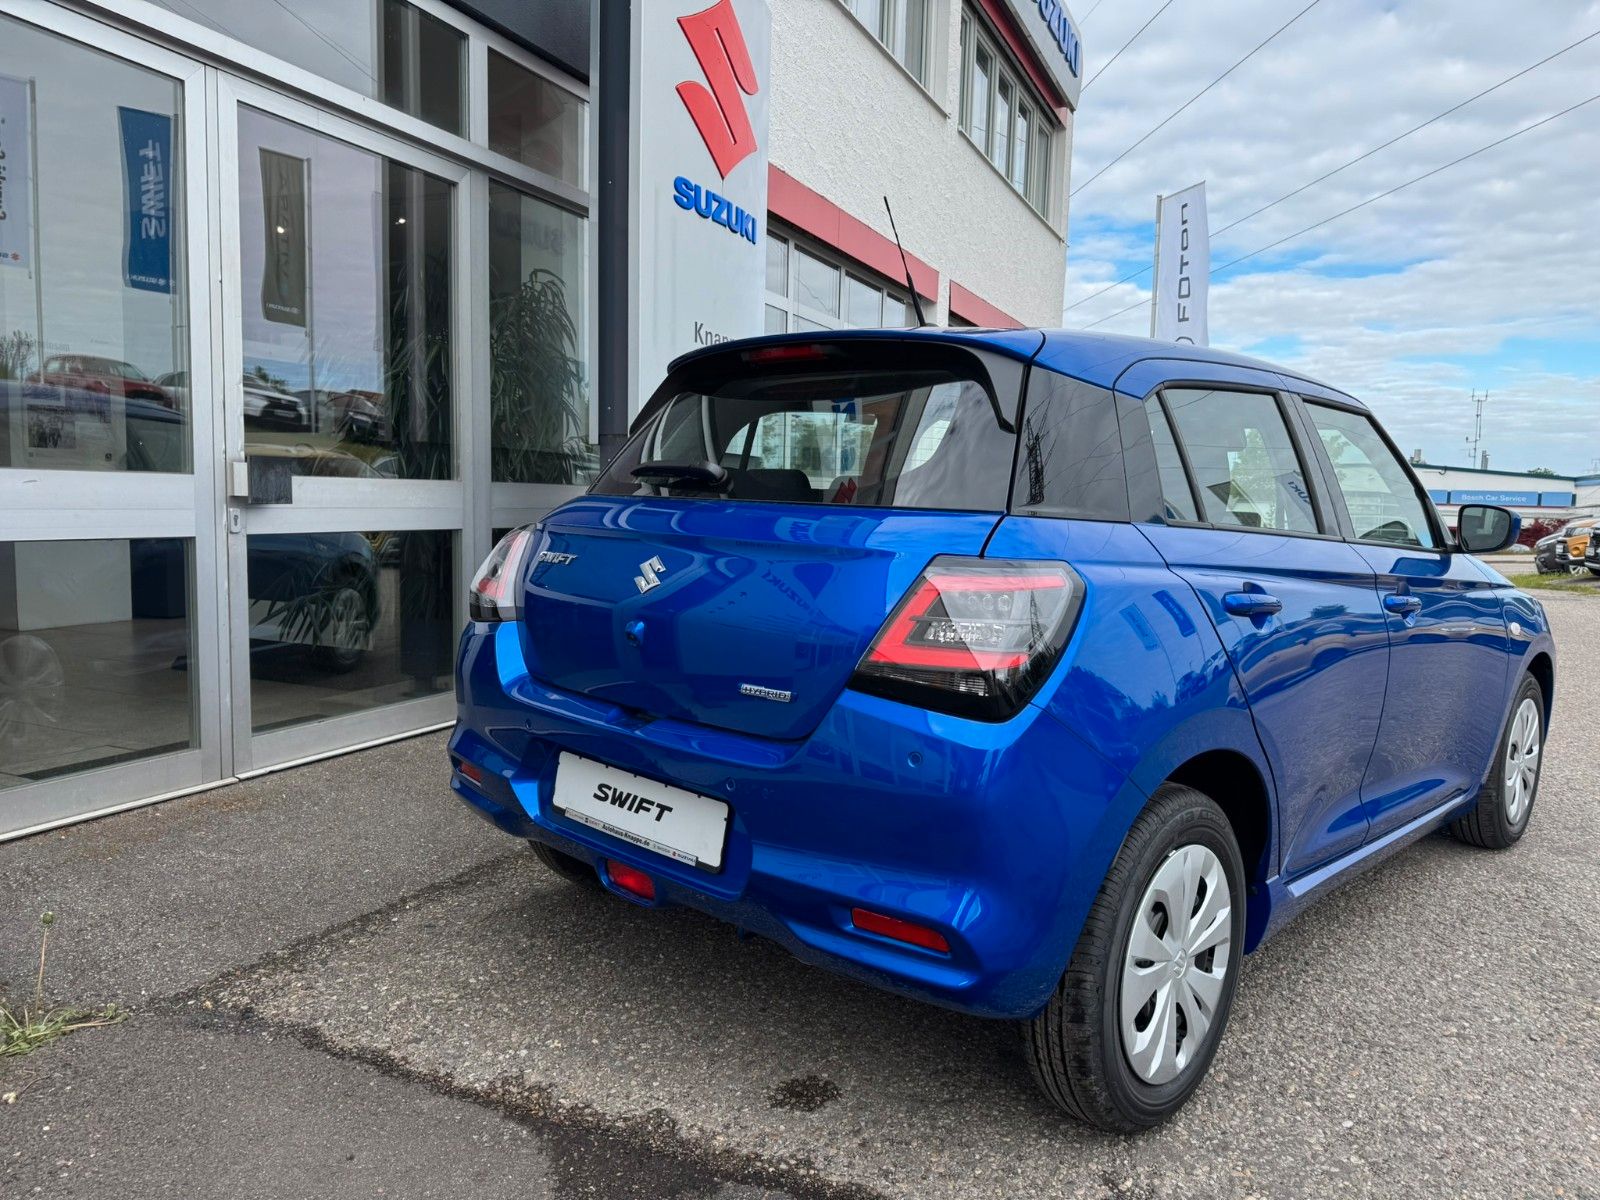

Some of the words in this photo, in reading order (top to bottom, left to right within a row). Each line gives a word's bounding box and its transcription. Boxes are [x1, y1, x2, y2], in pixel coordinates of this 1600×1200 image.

[1032, 0, 1080, 78] UZUKI
[673, 175, 757, 245] SUZUKI
[1500, 495, 1527, 503] Service
[539, 551, 578, 565] SWIFT
[741, 685, 790, 701] HYBRID
[592, 783, 674, 822] SWIFT
